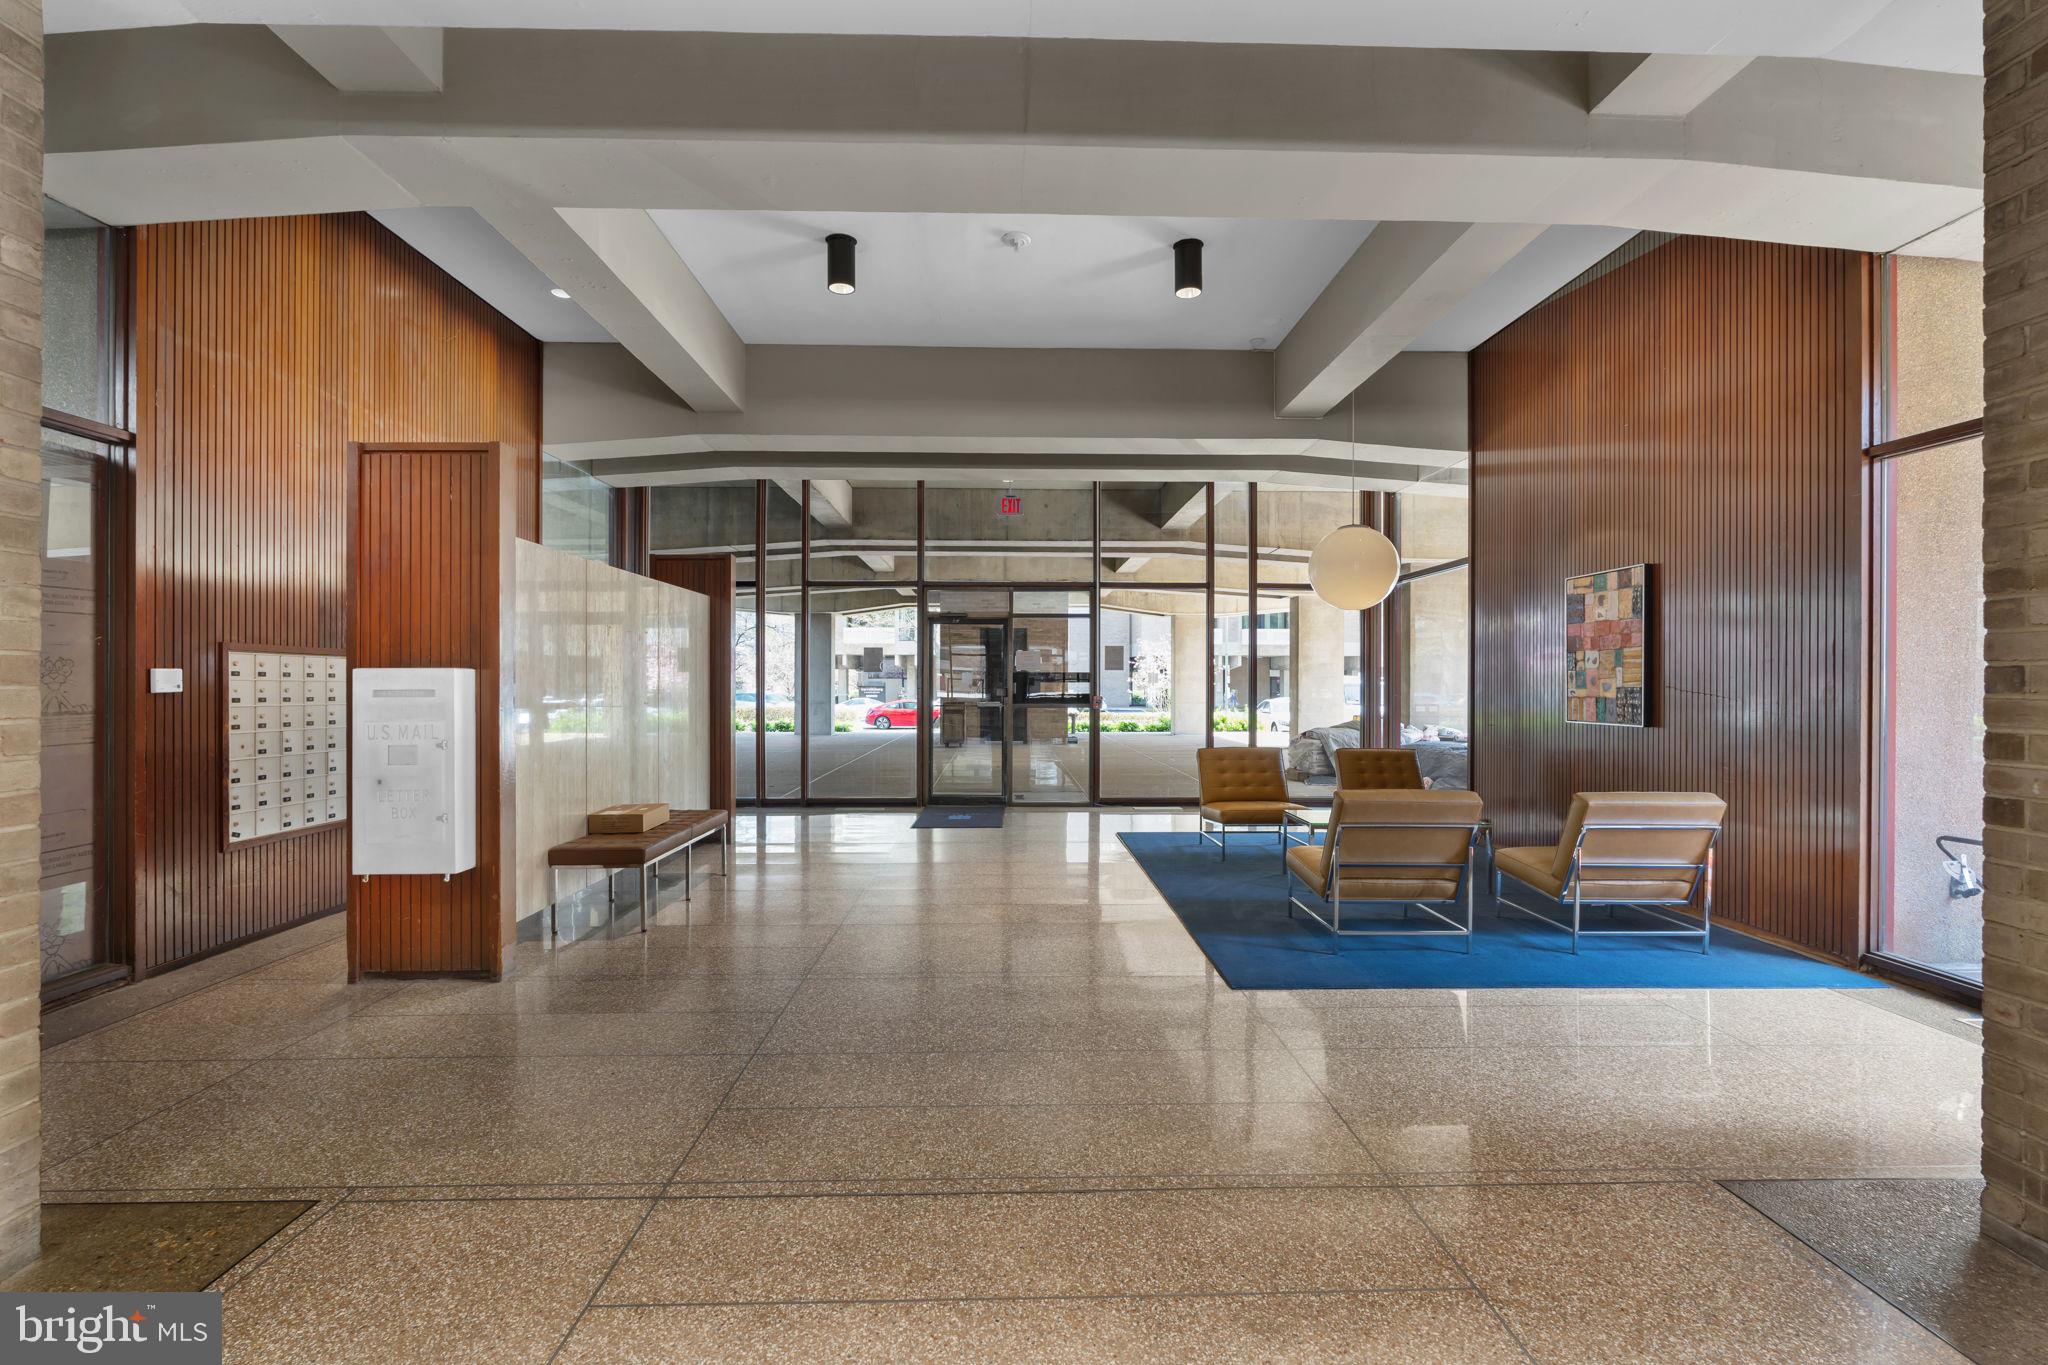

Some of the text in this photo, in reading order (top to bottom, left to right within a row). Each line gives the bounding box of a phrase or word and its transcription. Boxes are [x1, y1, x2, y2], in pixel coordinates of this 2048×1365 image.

[1001, 497, 1021, 513] EXIT
[398, 723, 439, 740] MAIL
[378, 788, 430, 803] LETTER
[391, 806, 417, 820] BOX
